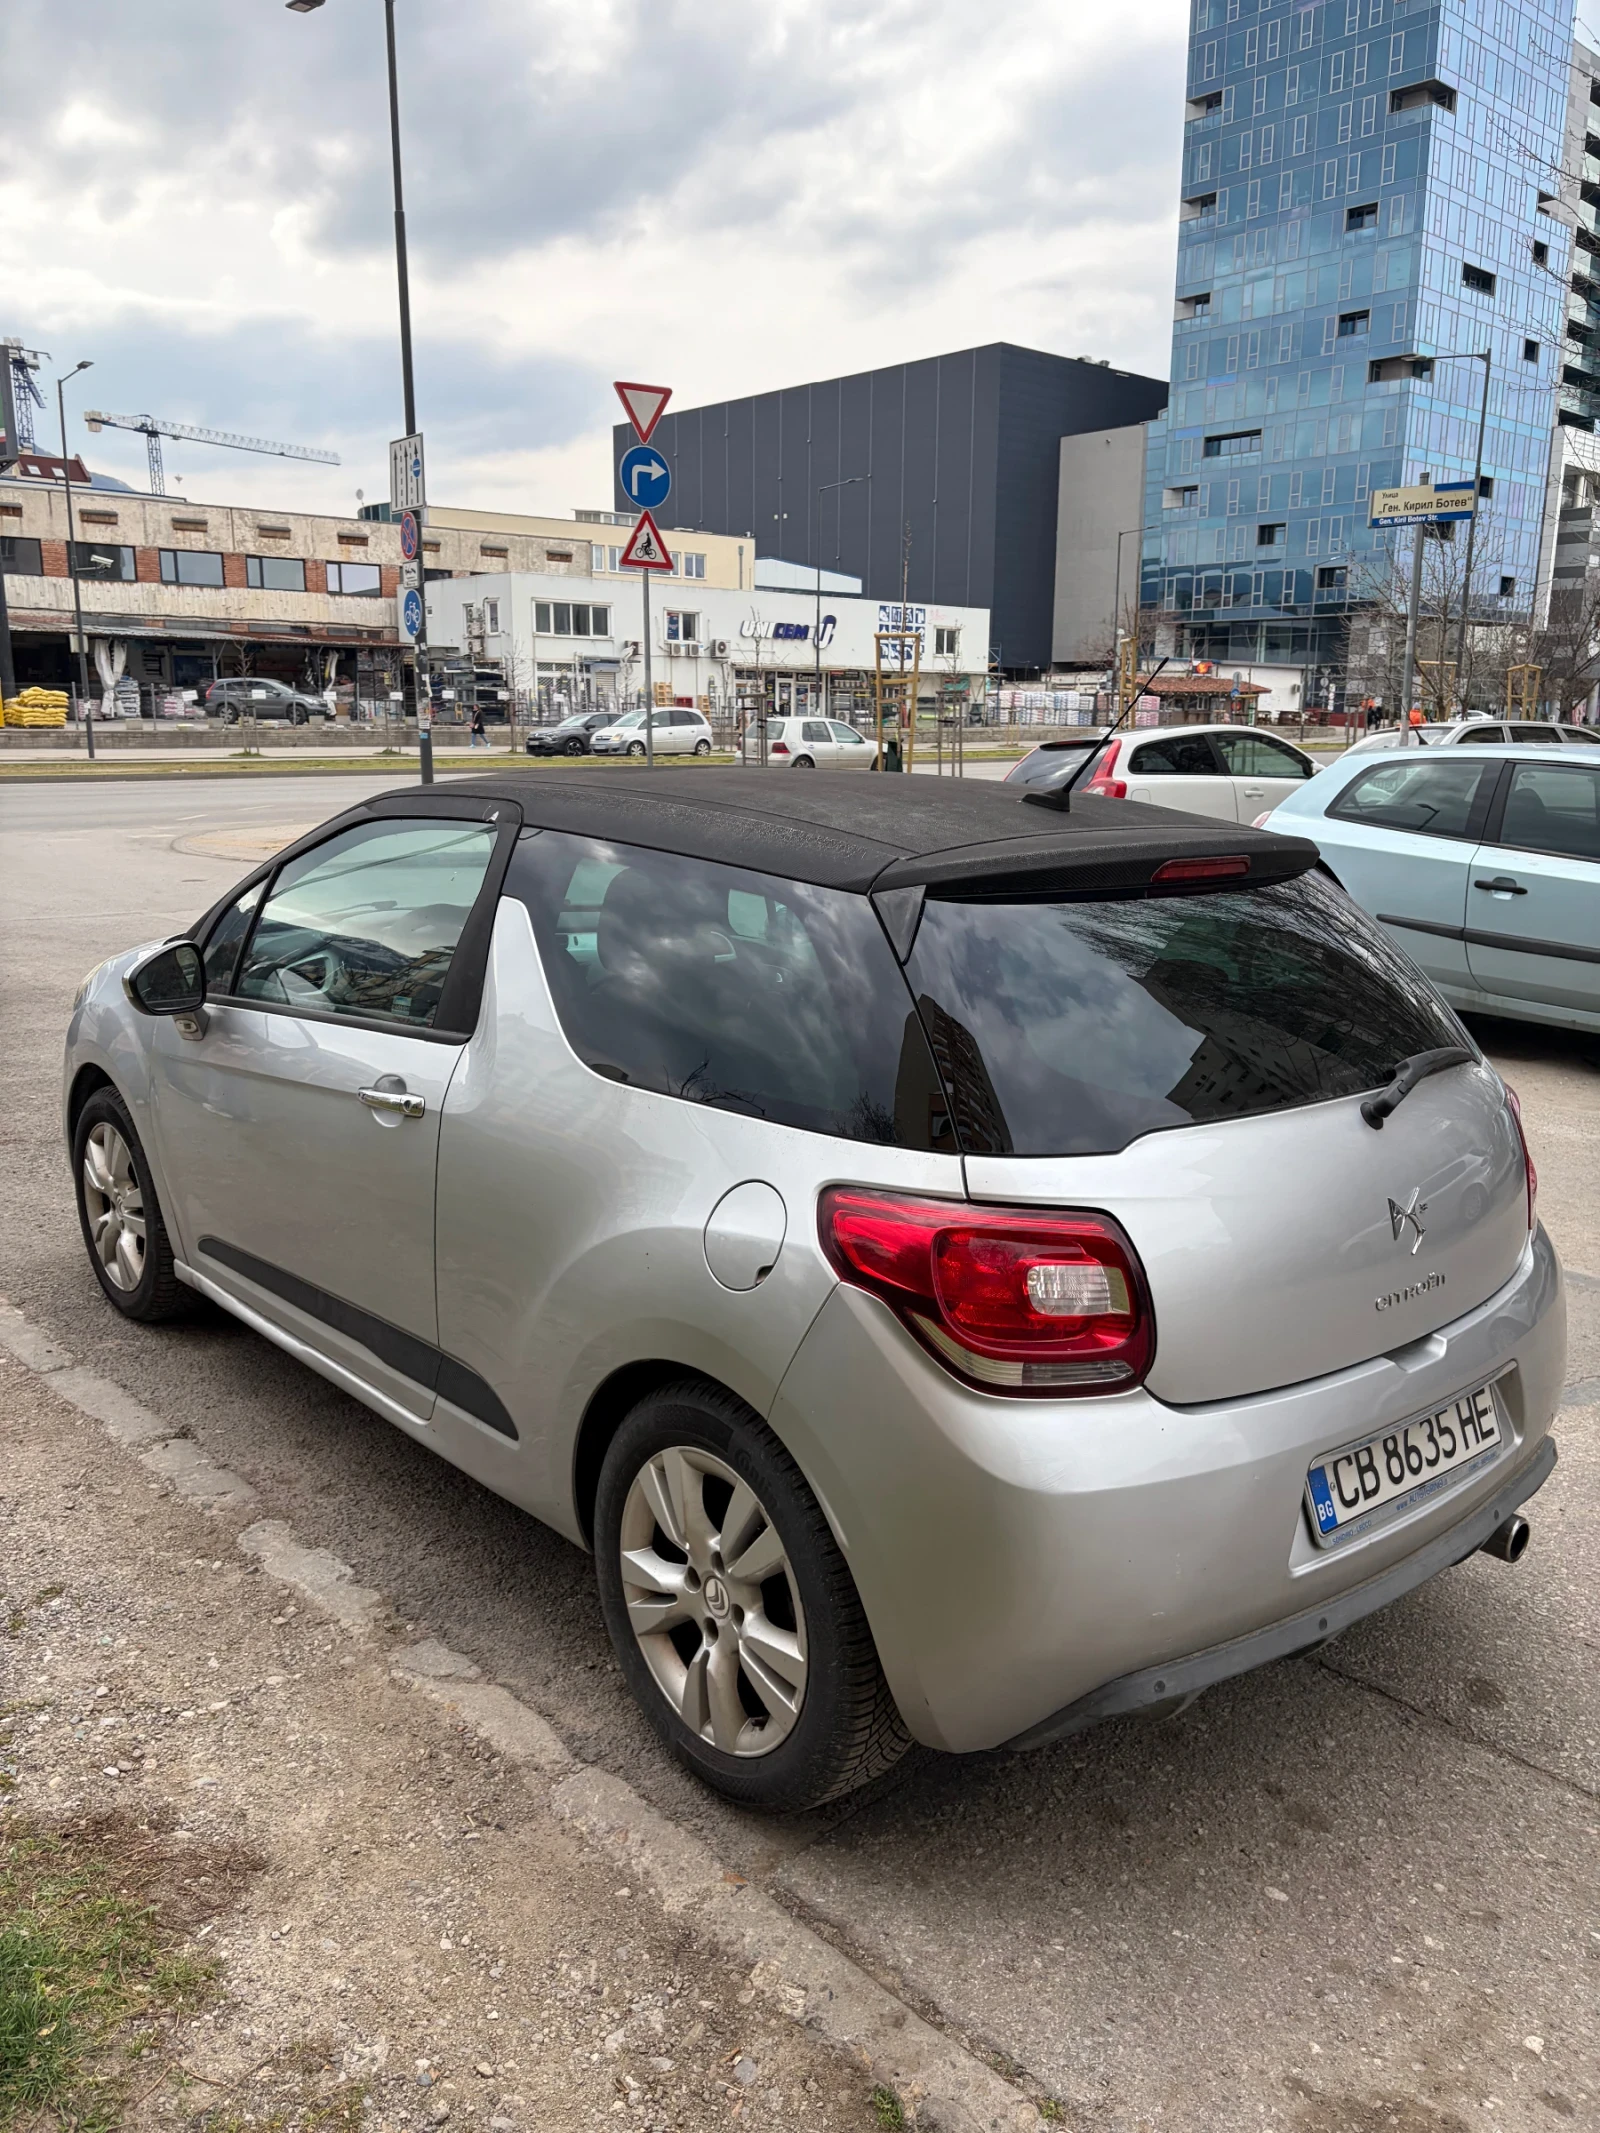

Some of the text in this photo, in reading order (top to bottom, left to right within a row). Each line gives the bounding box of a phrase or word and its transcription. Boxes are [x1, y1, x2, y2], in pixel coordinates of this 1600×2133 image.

[1403, 501, 1433, 512] Кирил
[740, 620, 810, 641] UNICEM
[1333, 1388, 1495, 1509] CB 8635 HE
[1316, 1500, 1333, 1522] BG
